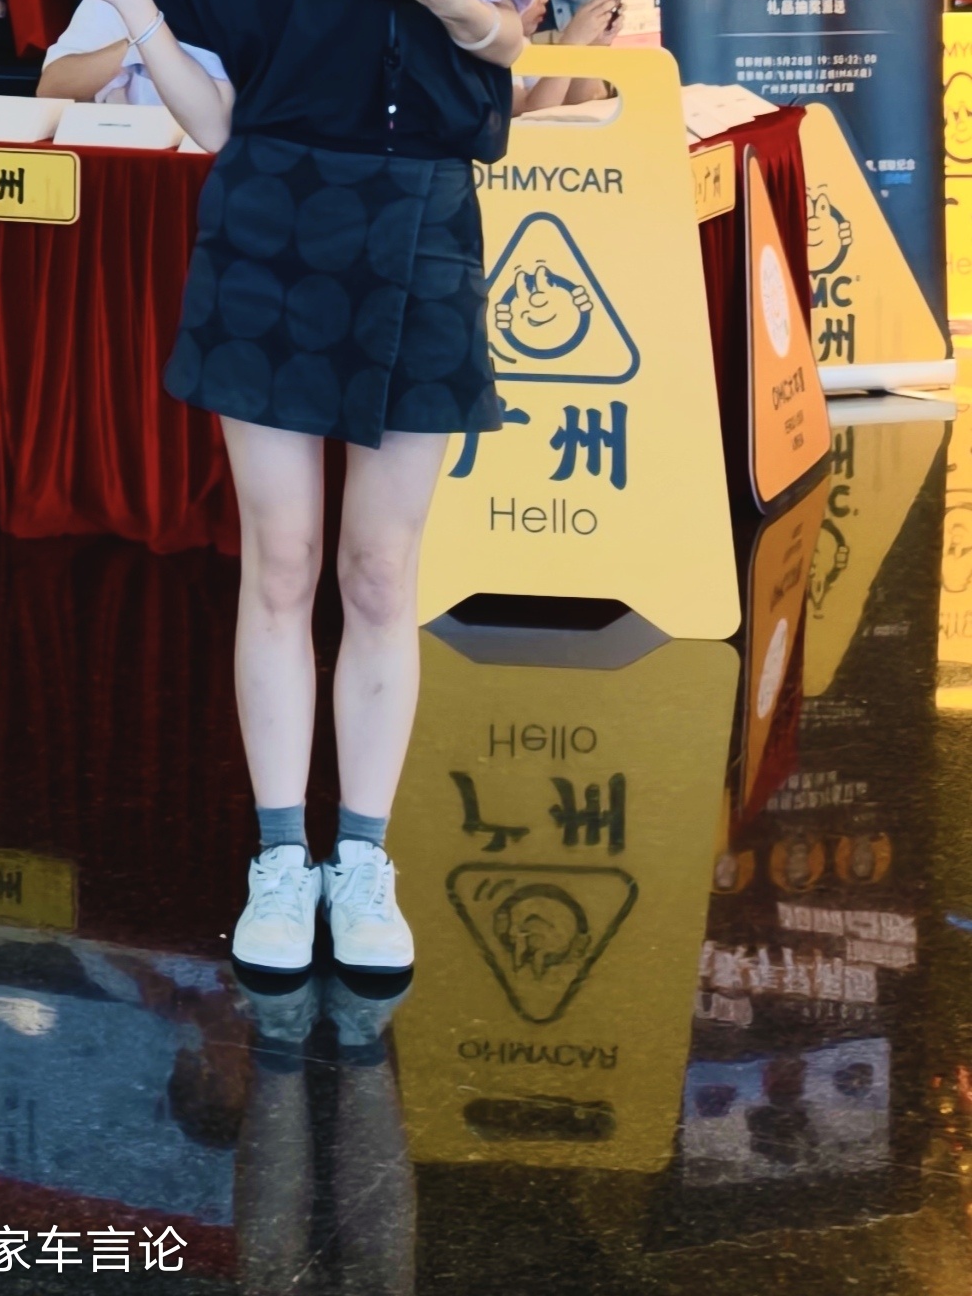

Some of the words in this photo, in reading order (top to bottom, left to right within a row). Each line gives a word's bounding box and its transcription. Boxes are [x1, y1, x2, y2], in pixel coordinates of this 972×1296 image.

[810, 275, 853, 308] MC
[818, 313, 855, 364] 州
[489, 497, 599, 536] Hello
